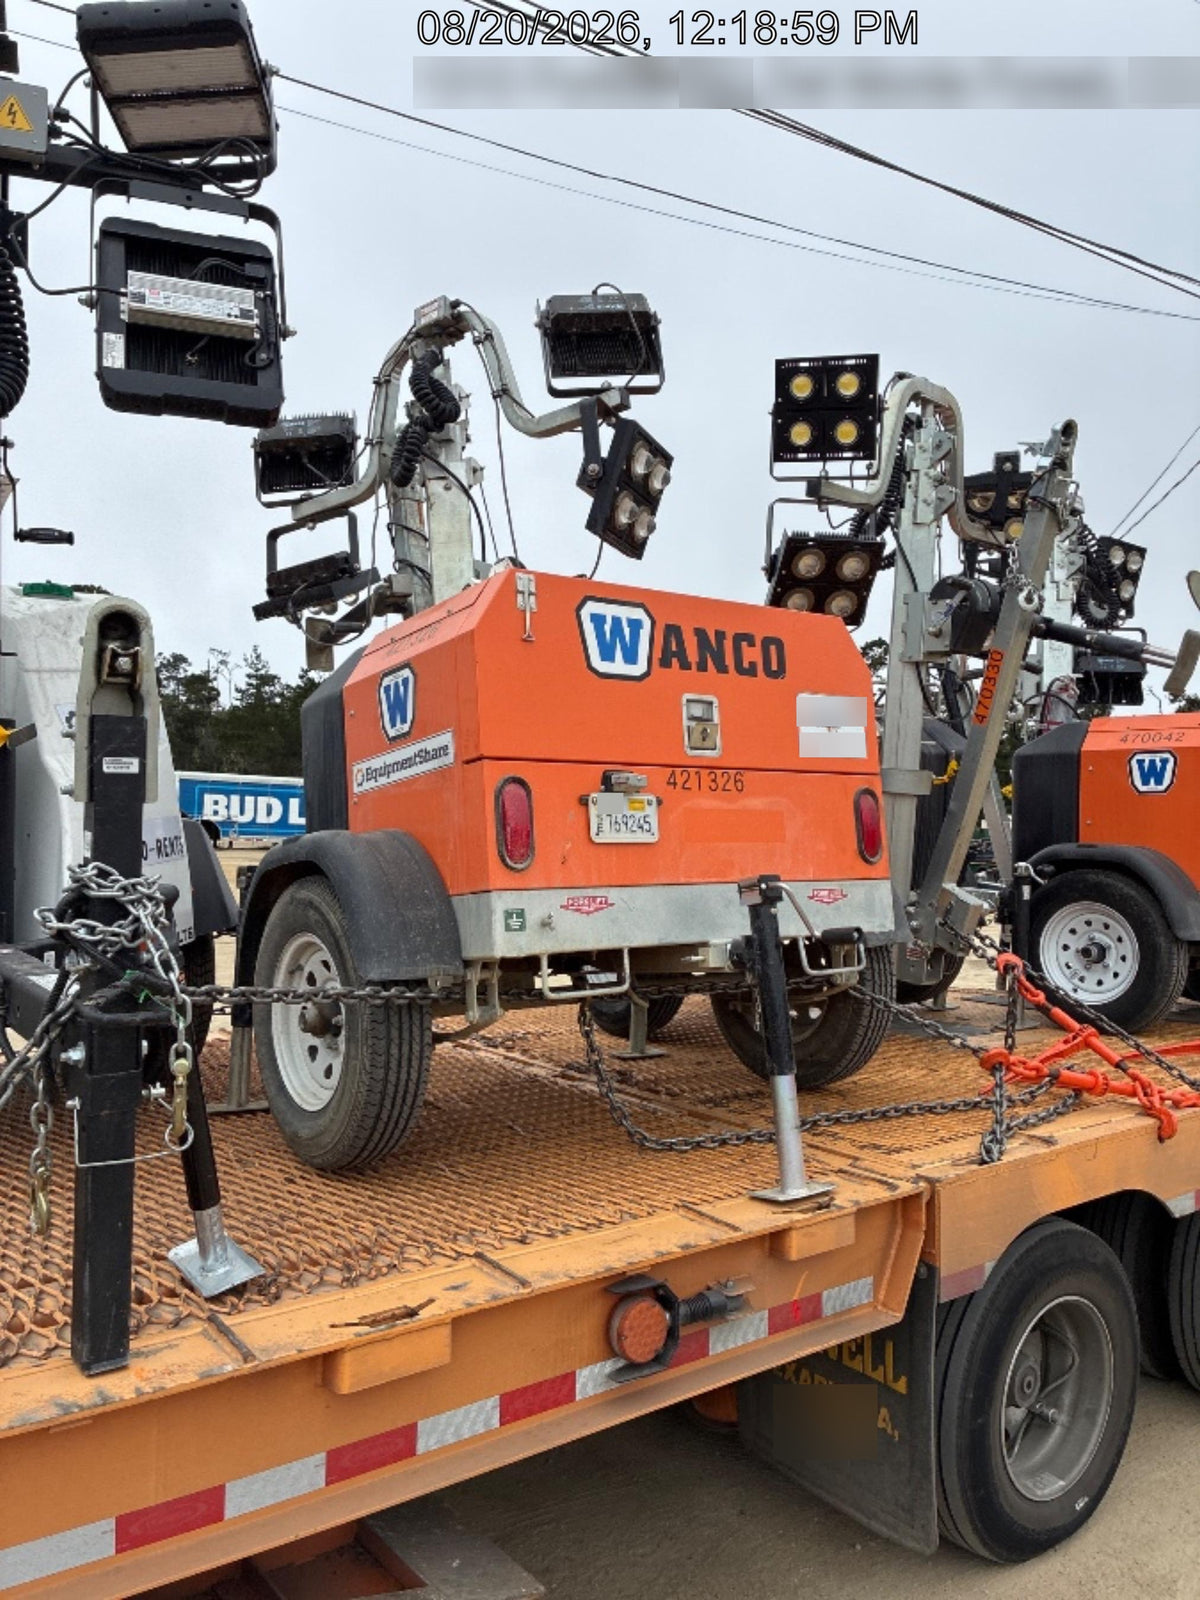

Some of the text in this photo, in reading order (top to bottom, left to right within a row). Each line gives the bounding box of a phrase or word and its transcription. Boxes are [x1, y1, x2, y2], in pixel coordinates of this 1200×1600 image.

[589, 612, 786, 679] WANCO
[975, 650, 1003, 724] 470330
[1120, 732, 1185, 743] 470042
[365, 744, 449, 782] EquipmentShare
[666, 770, 745, 792] 421326
[203, 793, 283, 824] BUD
[606, 813, 652, 833] 769245
